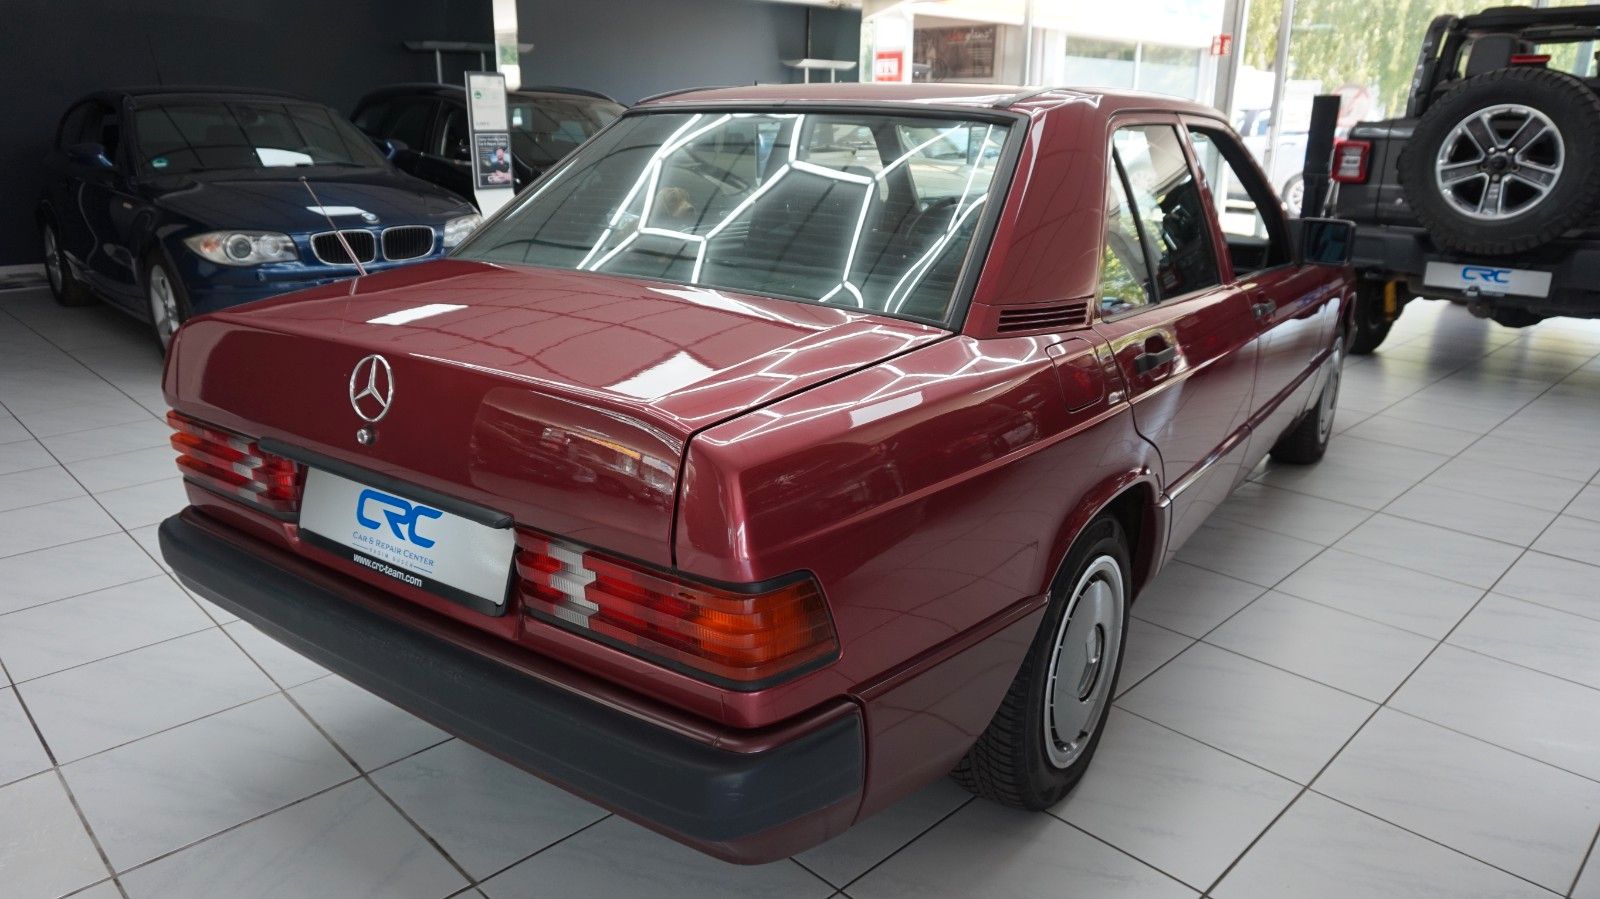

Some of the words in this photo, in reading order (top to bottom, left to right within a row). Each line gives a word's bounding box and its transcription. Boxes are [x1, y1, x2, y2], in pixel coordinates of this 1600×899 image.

[1462, 266, 1512, 283] CRC
[357, 489, 443, 548] CRC
[353, 553, 423, 588] www.crc-team.com
